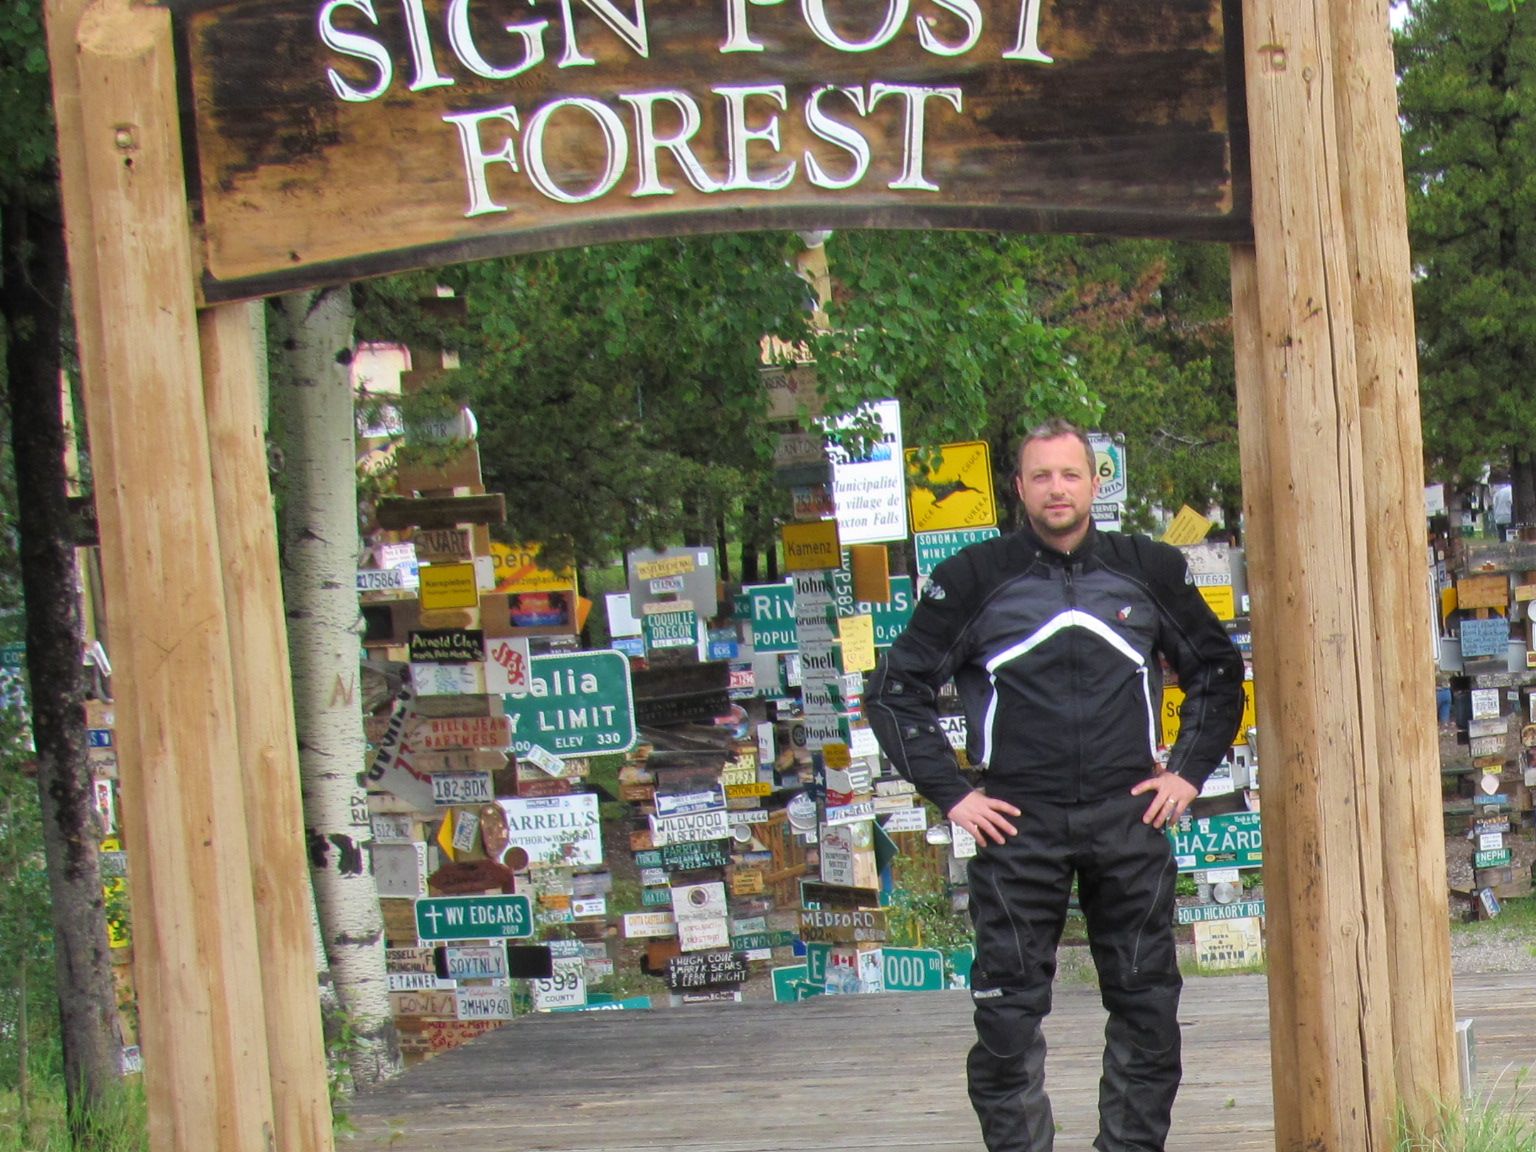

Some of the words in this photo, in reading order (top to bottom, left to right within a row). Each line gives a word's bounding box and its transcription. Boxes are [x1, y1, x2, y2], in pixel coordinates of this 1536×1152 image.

[318, 0, 651, 102] SIGN
[441, 82, 963, 217] FOREST
[846, 494, 881, 512] village
[887, 495, 900, 507] de
[873, 513, 900, 526] Falls
[919, 533, 958, 545] SONOMA
[787, 541, 831, 557] Kamenz
[921, 548, 946, 560] WINE
[649, 610, 694, 626] COQUILLE
[652, 624, 693, 639] OREGON
[802, 653, 835, 670] Snell
[805, 691, 845, 707] Hopkins
[539, 704, 616, 732] LIMIT
[555, 735, 584, 749] ELEV
[597, 732, 621, 745] 330
[805, 725, 846, 741] Hopkins
[657, 812, 723, 833] WILDWOOD
[665, 828, 709, 843] ALBERTA
[1174, 831, 1263, 855] HAZARD
[445, 906, 465, 926] WV
[470, 903, 524, 925] EDGARS
[801, 911, 876, 929] MEDFORD
[1183, 908, 1201, 922] OLD
[1203, 904, 1245, 919] HICKORY
[501, 924, 520, 935] 2009
[450, 958, 501, 976] SOYTNLY
[884, 955, 926, 987] OOD
[400, 974, 437, 988] TANNER
[545, 993, 576, 1002] COUNTY
